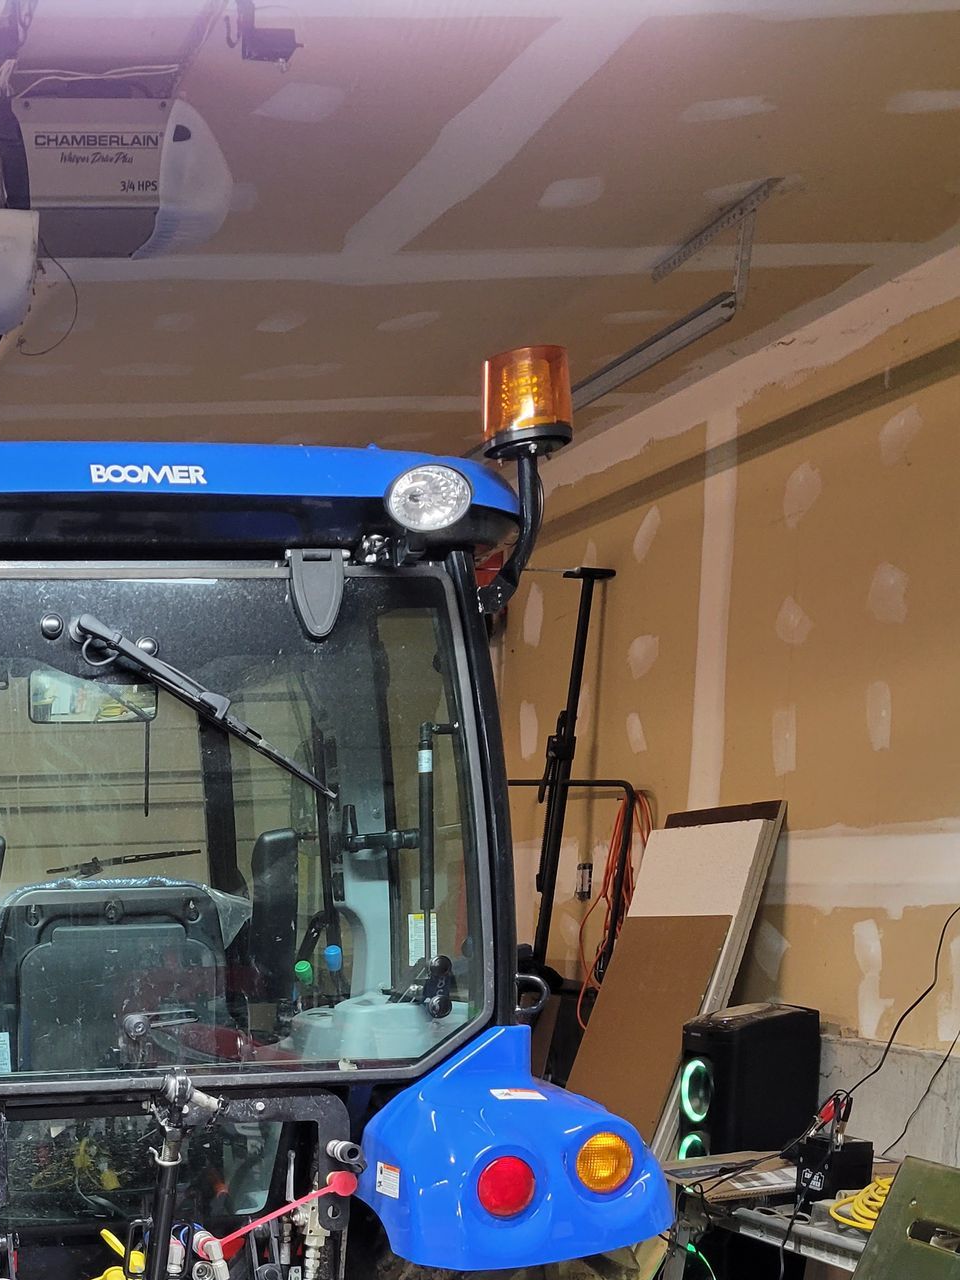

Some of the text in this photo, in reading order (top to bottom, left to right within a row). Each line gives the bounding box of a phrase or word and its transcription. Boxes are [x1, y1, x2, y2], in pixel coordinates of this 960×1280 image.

[34, 134, 159, 147] CHAMBERLAIN
[120, 180, 158, 193] 3/4 HPS
[89, 464, 208, 484] BOOMER
